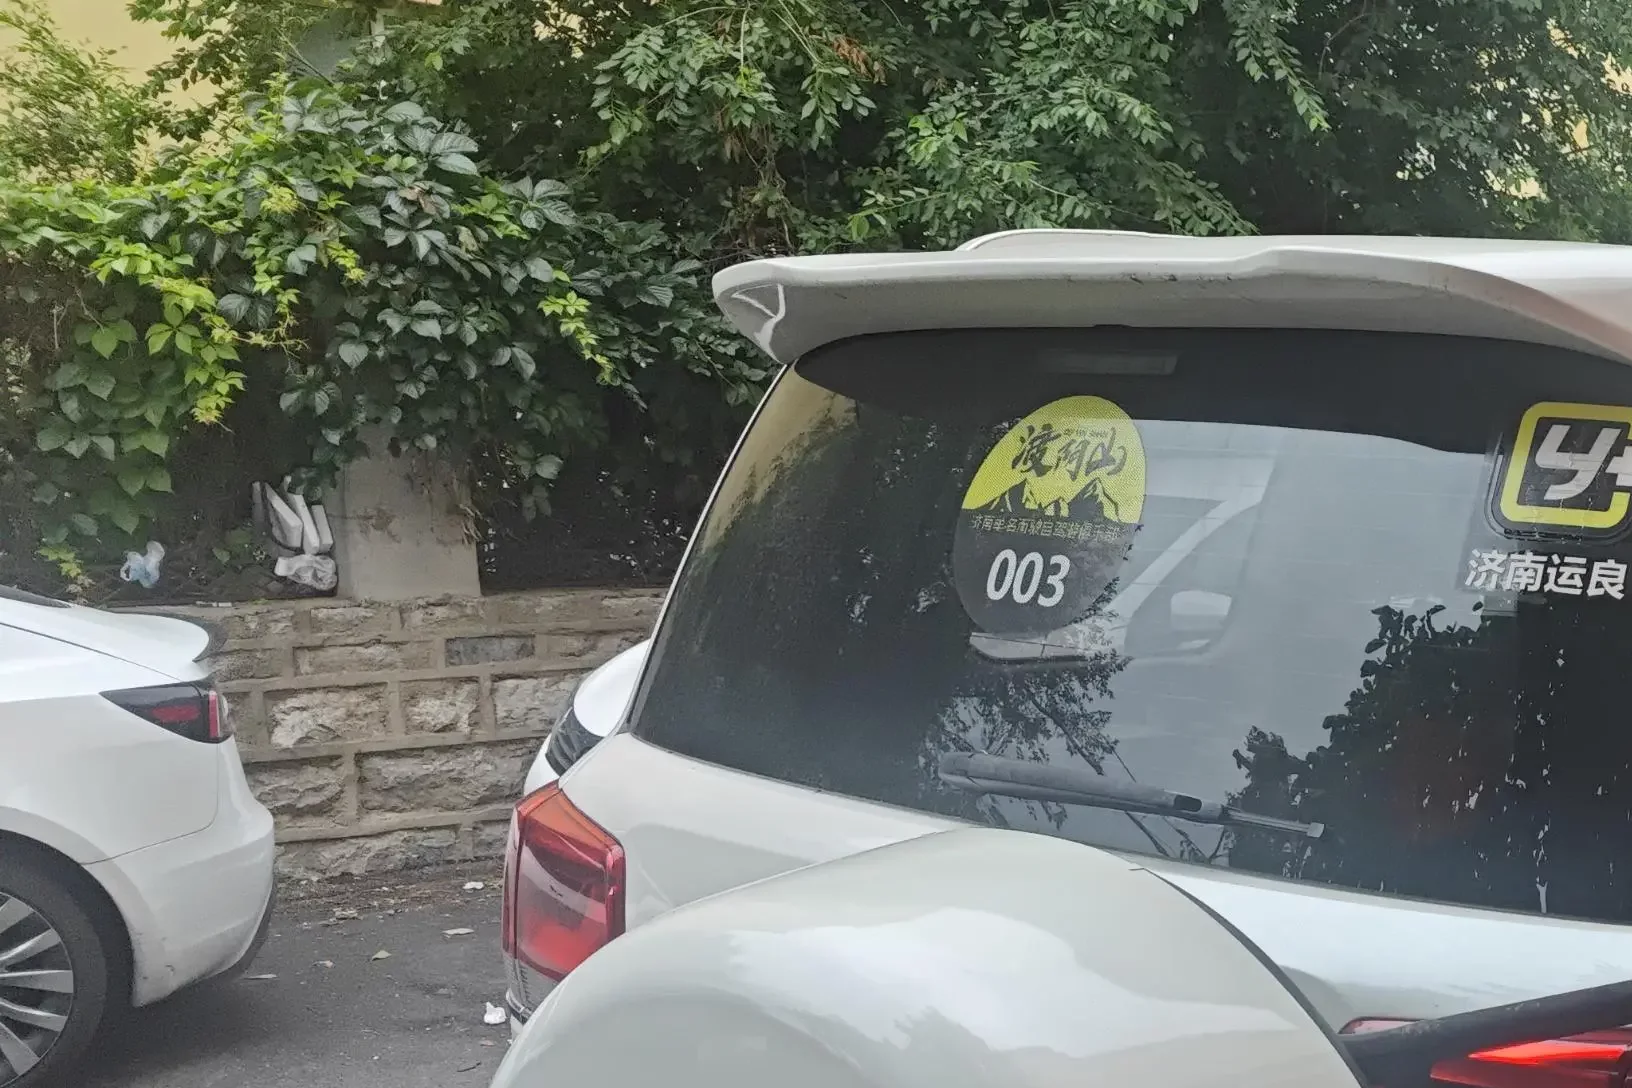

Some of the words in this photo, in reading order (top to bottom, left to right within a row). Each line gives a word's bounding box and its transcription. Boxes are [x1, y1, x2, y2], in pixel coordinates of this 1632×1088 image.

[986, 549, 1071, 607] 003
[1464, 549, 1628, 600] 济南运良
